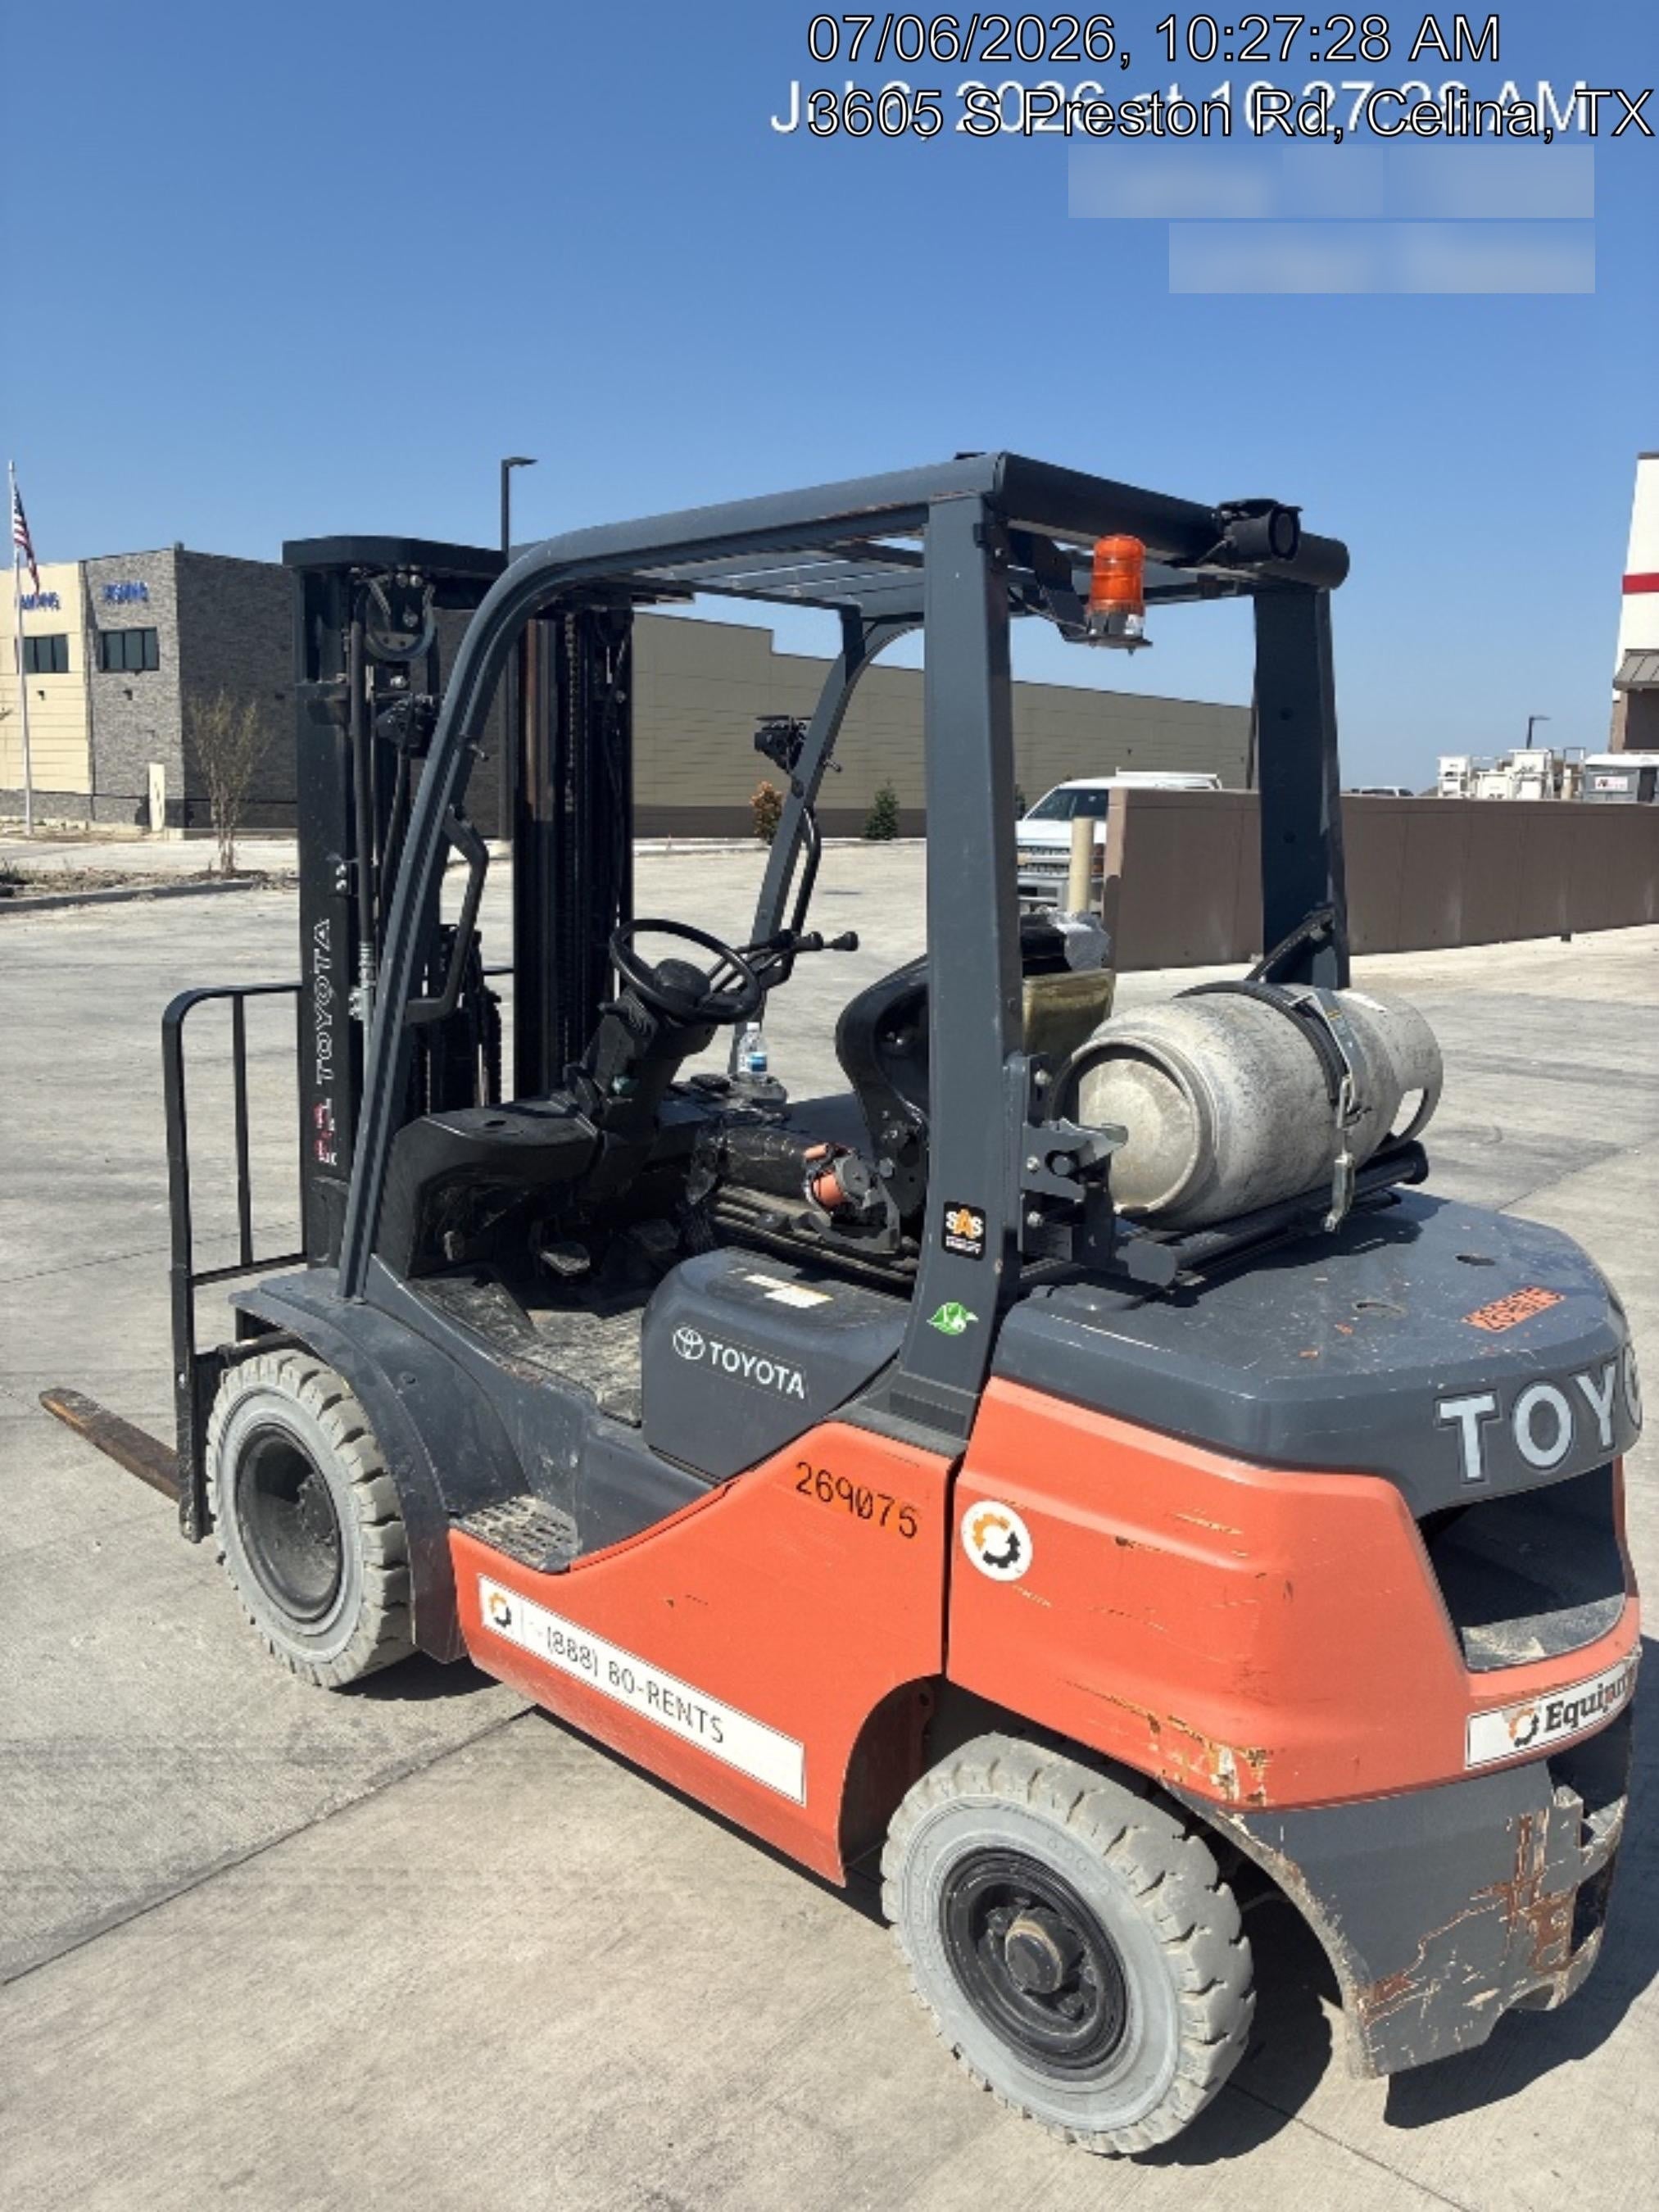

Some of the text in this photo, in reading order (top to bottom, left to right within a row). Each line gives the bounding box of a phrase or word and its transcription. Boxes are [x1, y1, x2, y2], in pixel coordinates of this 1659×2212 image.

[314, 919, 334, 1086] TOYOTA
[945, 1208, 984, 1239] SAS
[709, 1341, 805, 1400] TOYOTA
[796, 1461, 918, 1539] 269075
